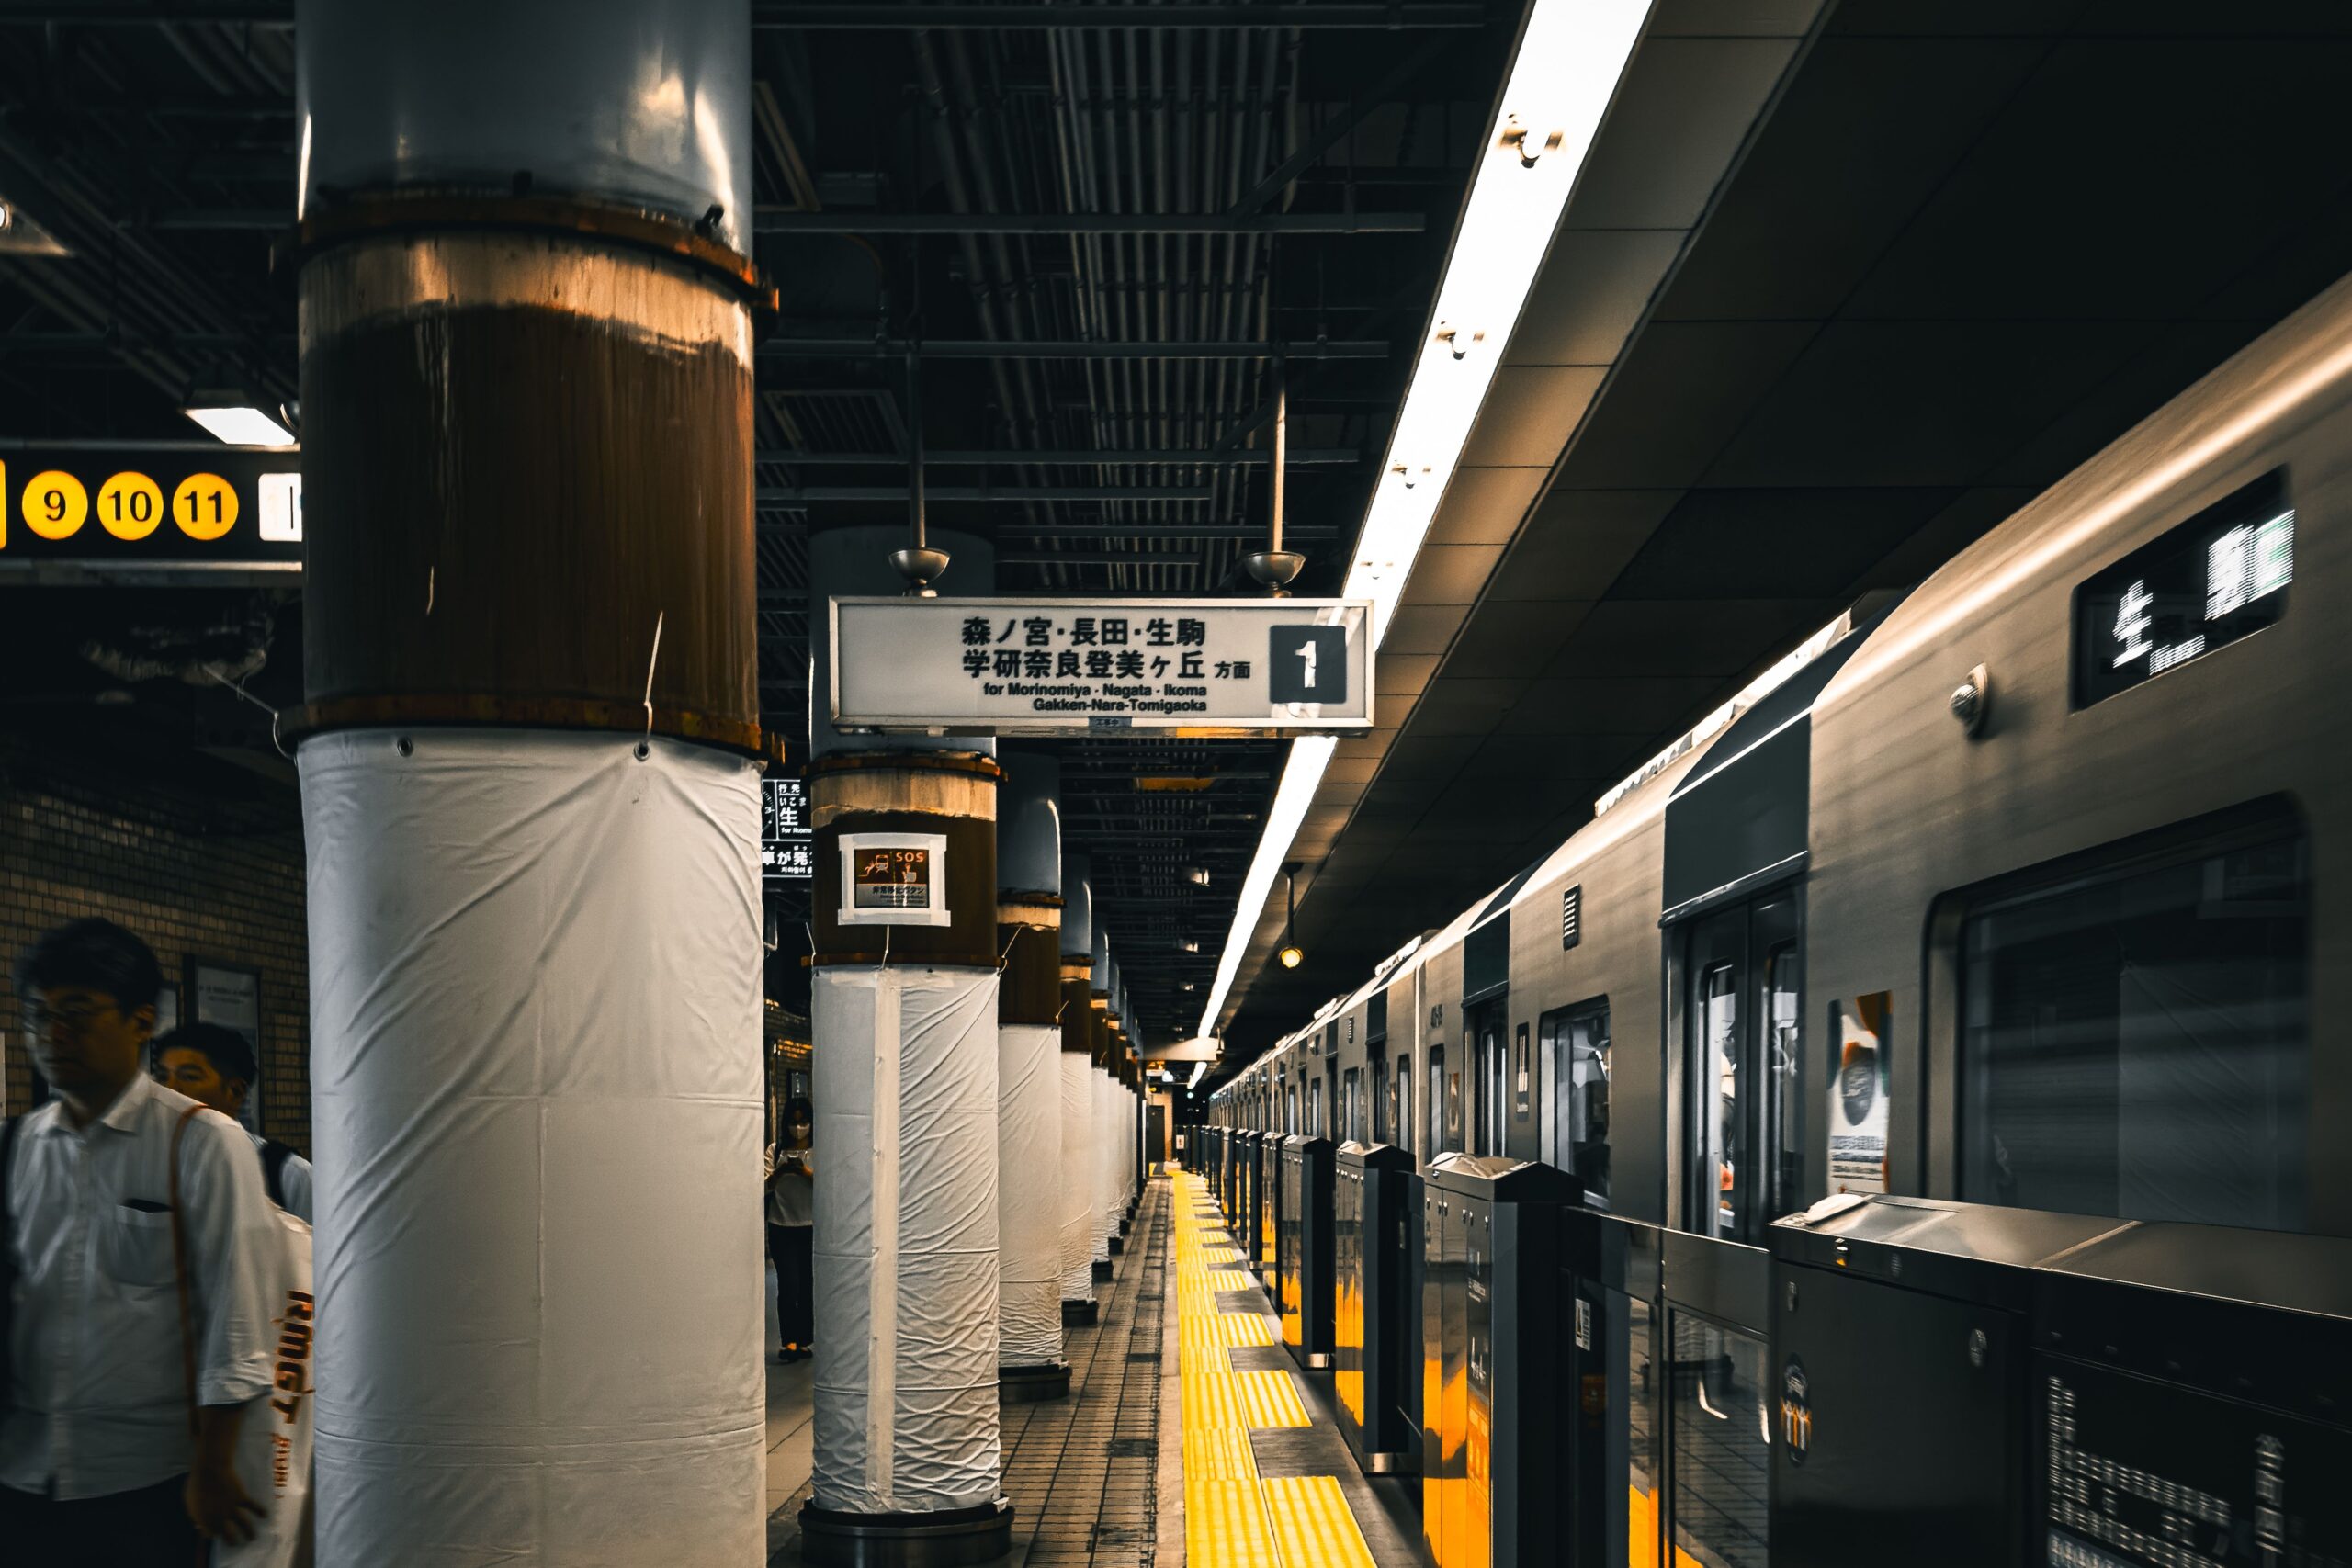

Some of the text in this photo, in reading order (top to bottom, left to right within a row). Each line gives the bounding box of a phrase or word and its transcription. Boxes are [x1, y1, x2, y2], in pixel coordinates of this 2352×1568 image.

[43, 490, 222, 524] 9 10 11
[1214, 660, 1251, 679] 方面
[1295, 640, 1317, 688] 1
[984, 682, 1207, 699] for Morinomiya Nagata Ikoma
[1033, 698, 1207, 715] Gakken-Nara-Tomigaoka
[896, 852, 925, 863] SOS
